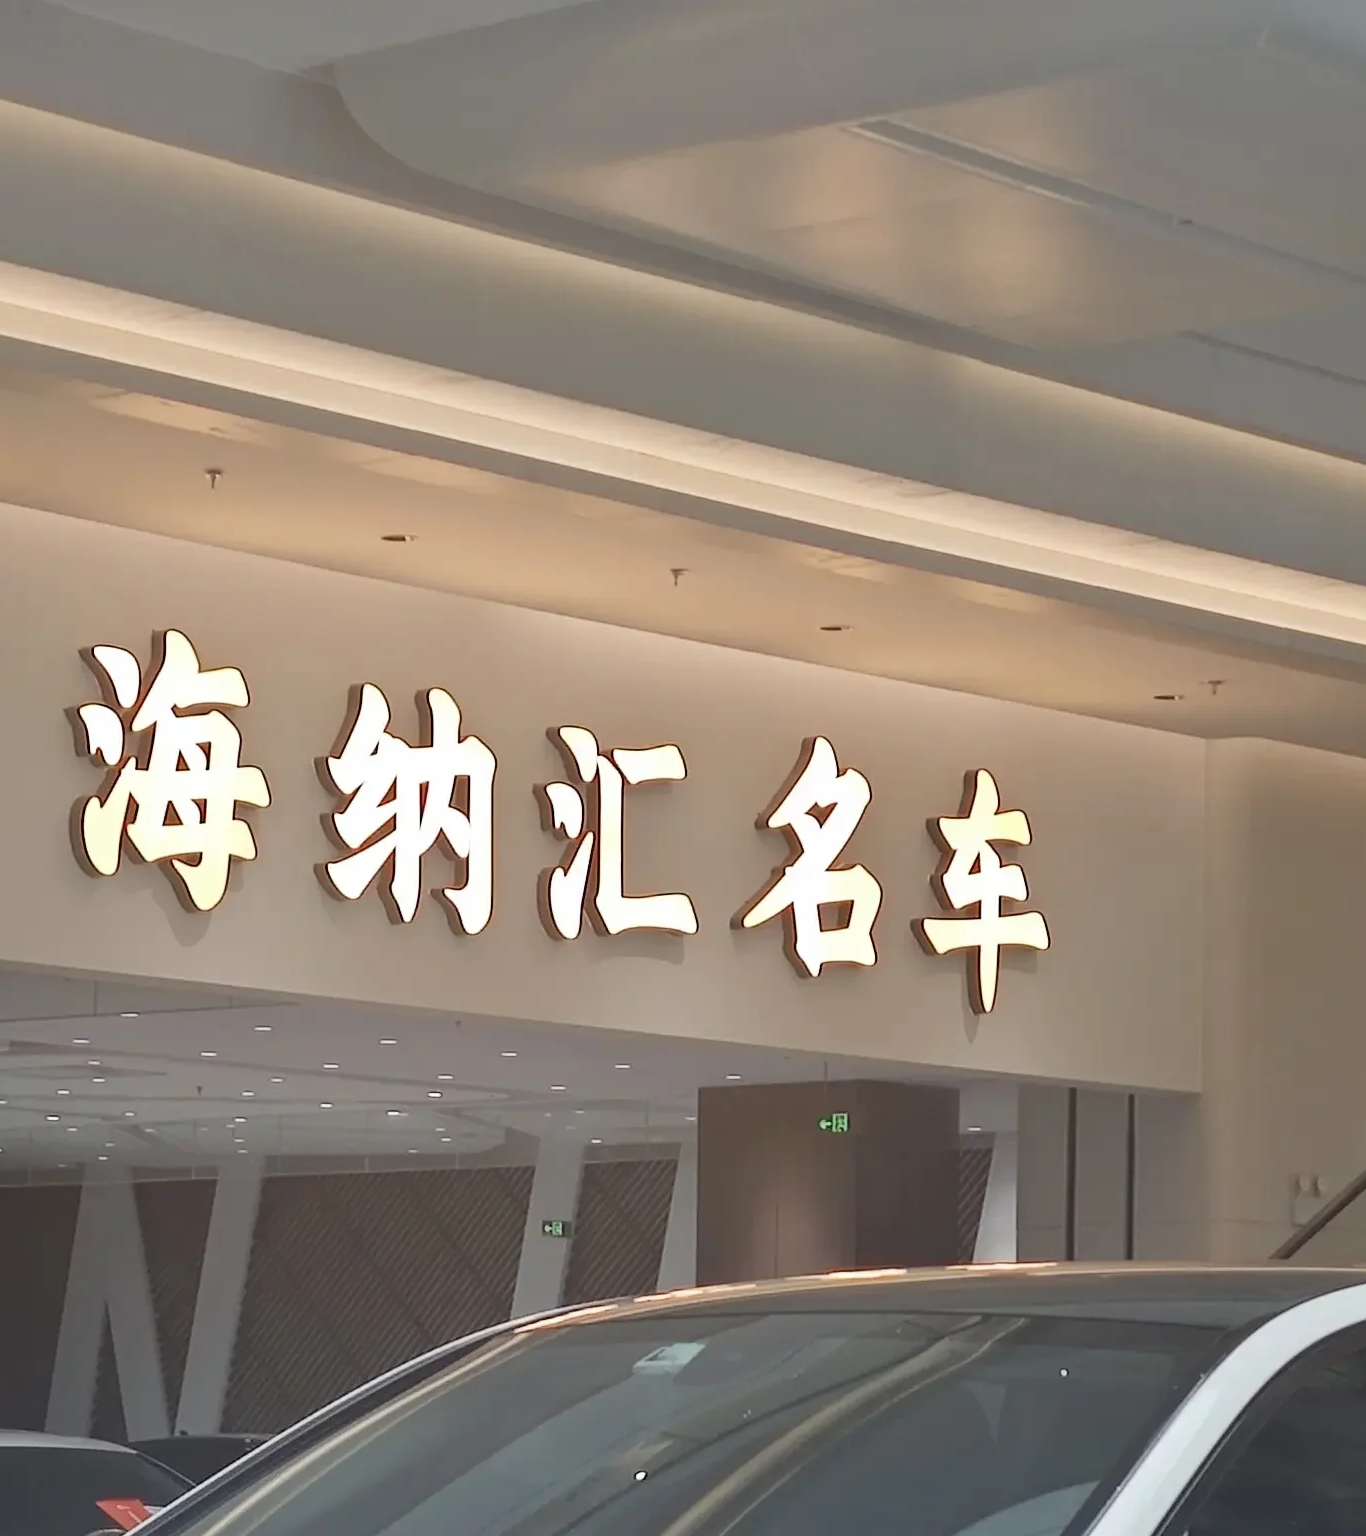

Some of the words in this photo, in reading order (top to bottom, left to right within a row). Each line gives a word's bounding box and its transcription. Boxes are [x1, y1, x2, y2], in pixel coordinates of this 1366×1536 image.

[71, 630, 1050, 1014] 海纳汇名车
